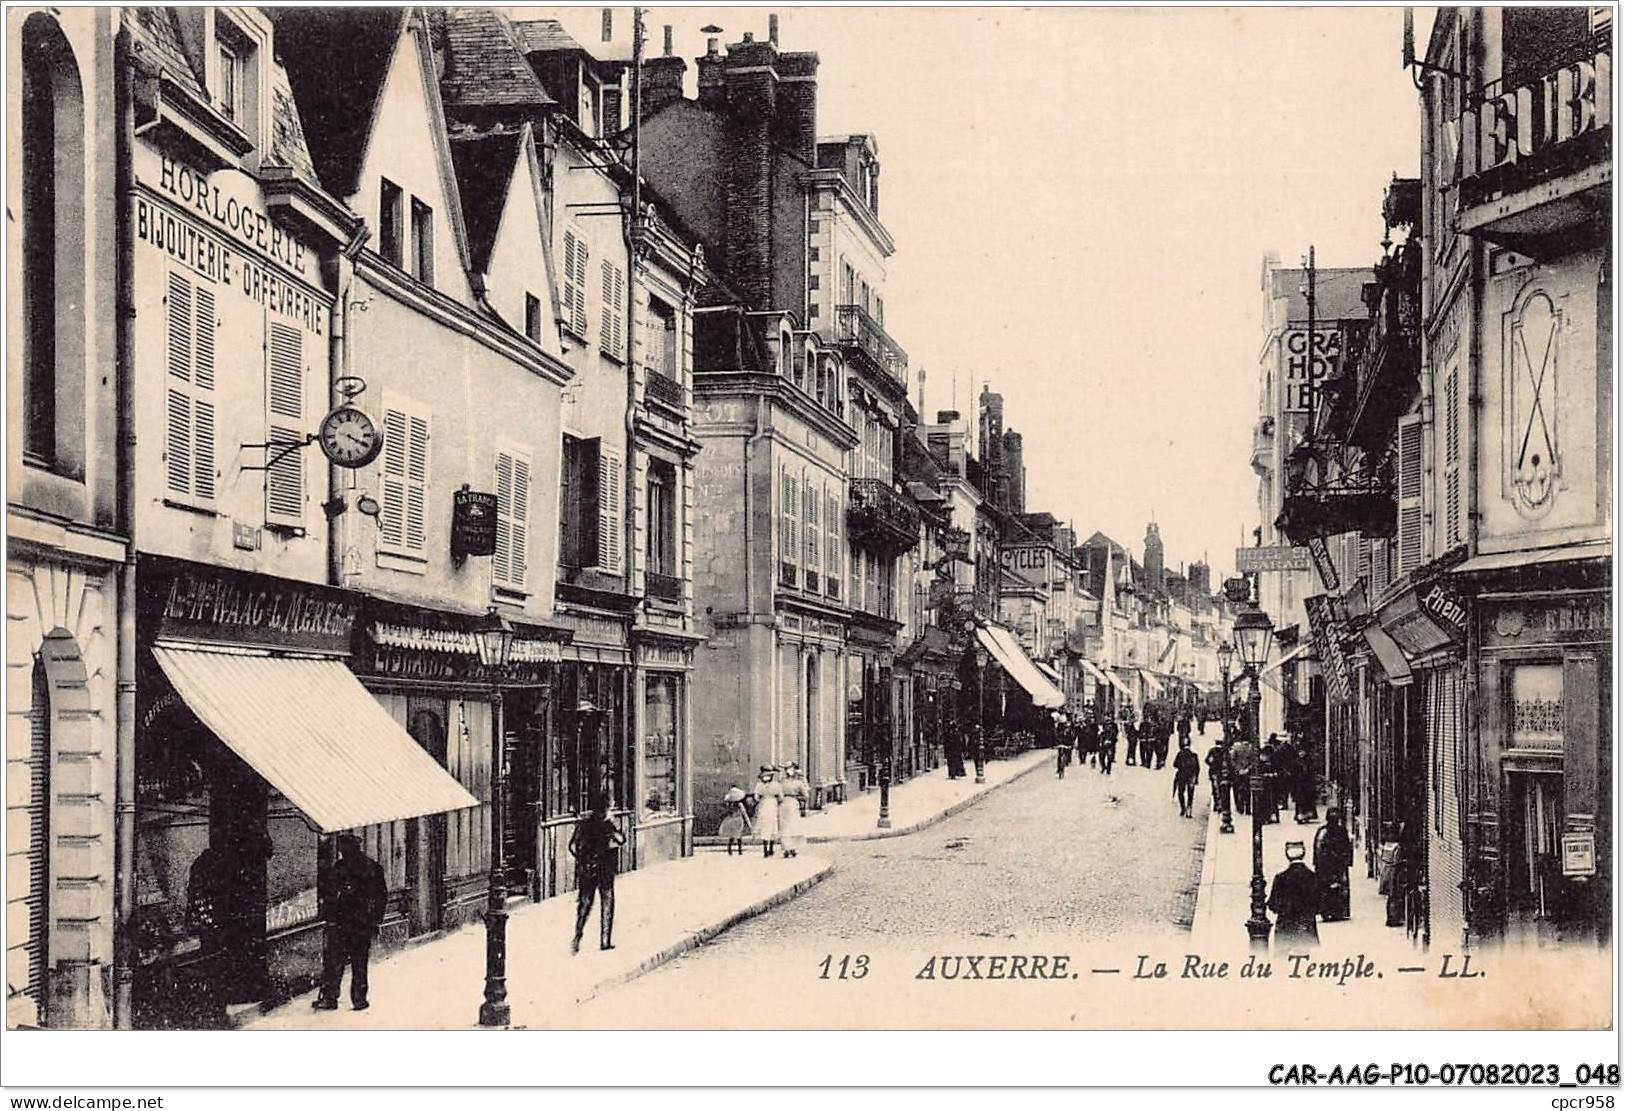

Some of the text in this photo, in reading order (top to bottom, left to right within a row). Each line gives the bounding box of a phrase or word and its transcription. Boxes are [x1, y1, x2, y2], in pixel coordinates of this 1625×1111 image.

[138, 200, 230, 285] BIJOUTERIE
[160, 156, 305, 274] HORLOGERIE
[1001, 549, 1046, 569] CYCLES
